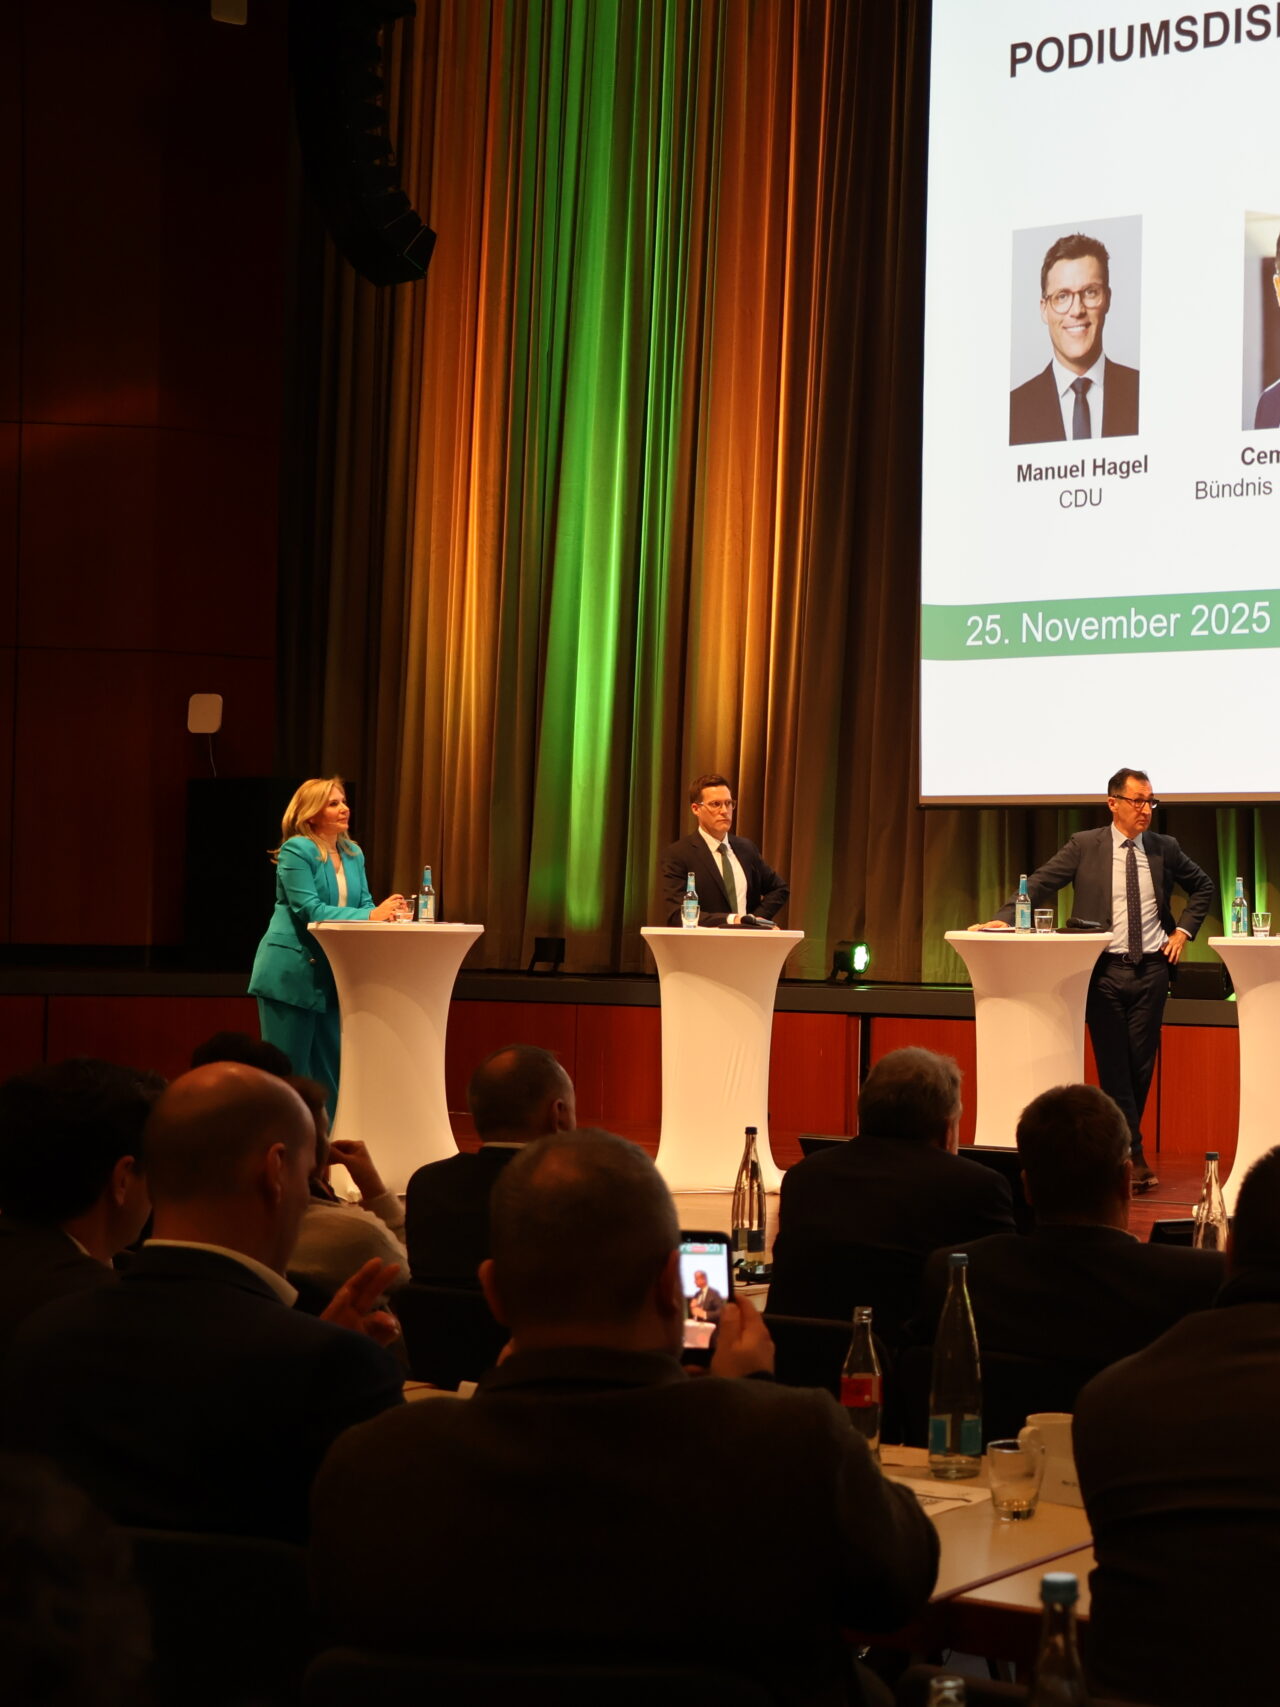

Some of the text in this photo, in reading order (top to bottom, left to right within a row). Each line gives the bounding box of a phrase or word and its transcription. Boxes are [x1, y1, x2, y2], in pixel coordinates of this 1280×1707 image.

[1016, 454, 1149, 483] Manuel Hagel
[1059, 487, 1103, 509] CDU
[1195, 475, 1273, 500] Bündnis
[965, 614, 1010, 646] 25.
[1021, 606, 1182, 644] November
[1190, 601, 1271, 637] 2025
